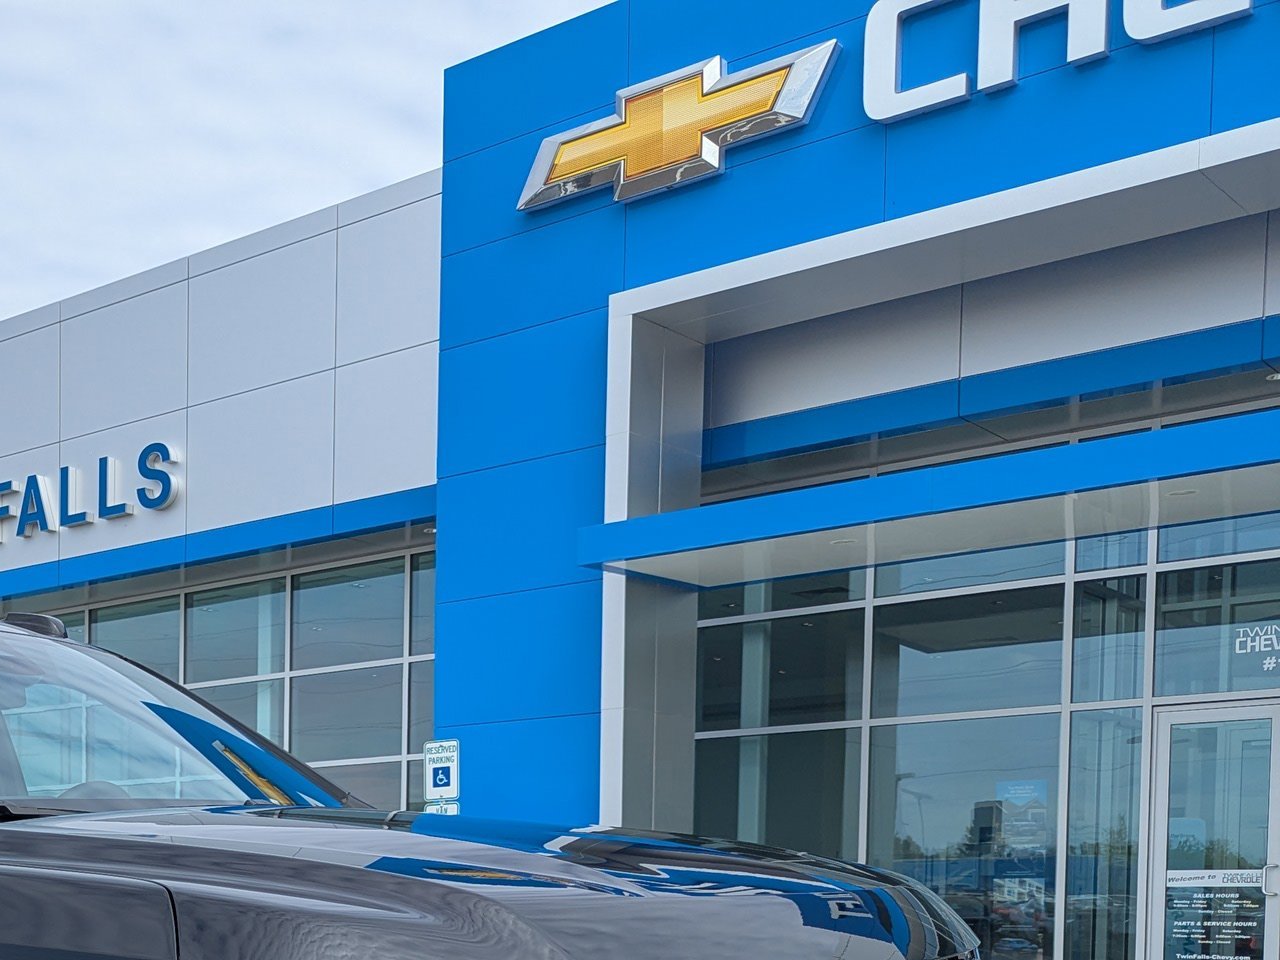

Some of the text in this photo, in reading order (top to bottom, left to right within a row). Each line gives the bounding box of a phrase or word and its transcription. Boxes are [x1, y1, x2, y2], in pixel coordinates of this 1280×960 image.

[426, 745, 457, 755] RESERVED
[428, 755, 455, 765] PARKING
[1168, 874, 1205, 883] Welcome
